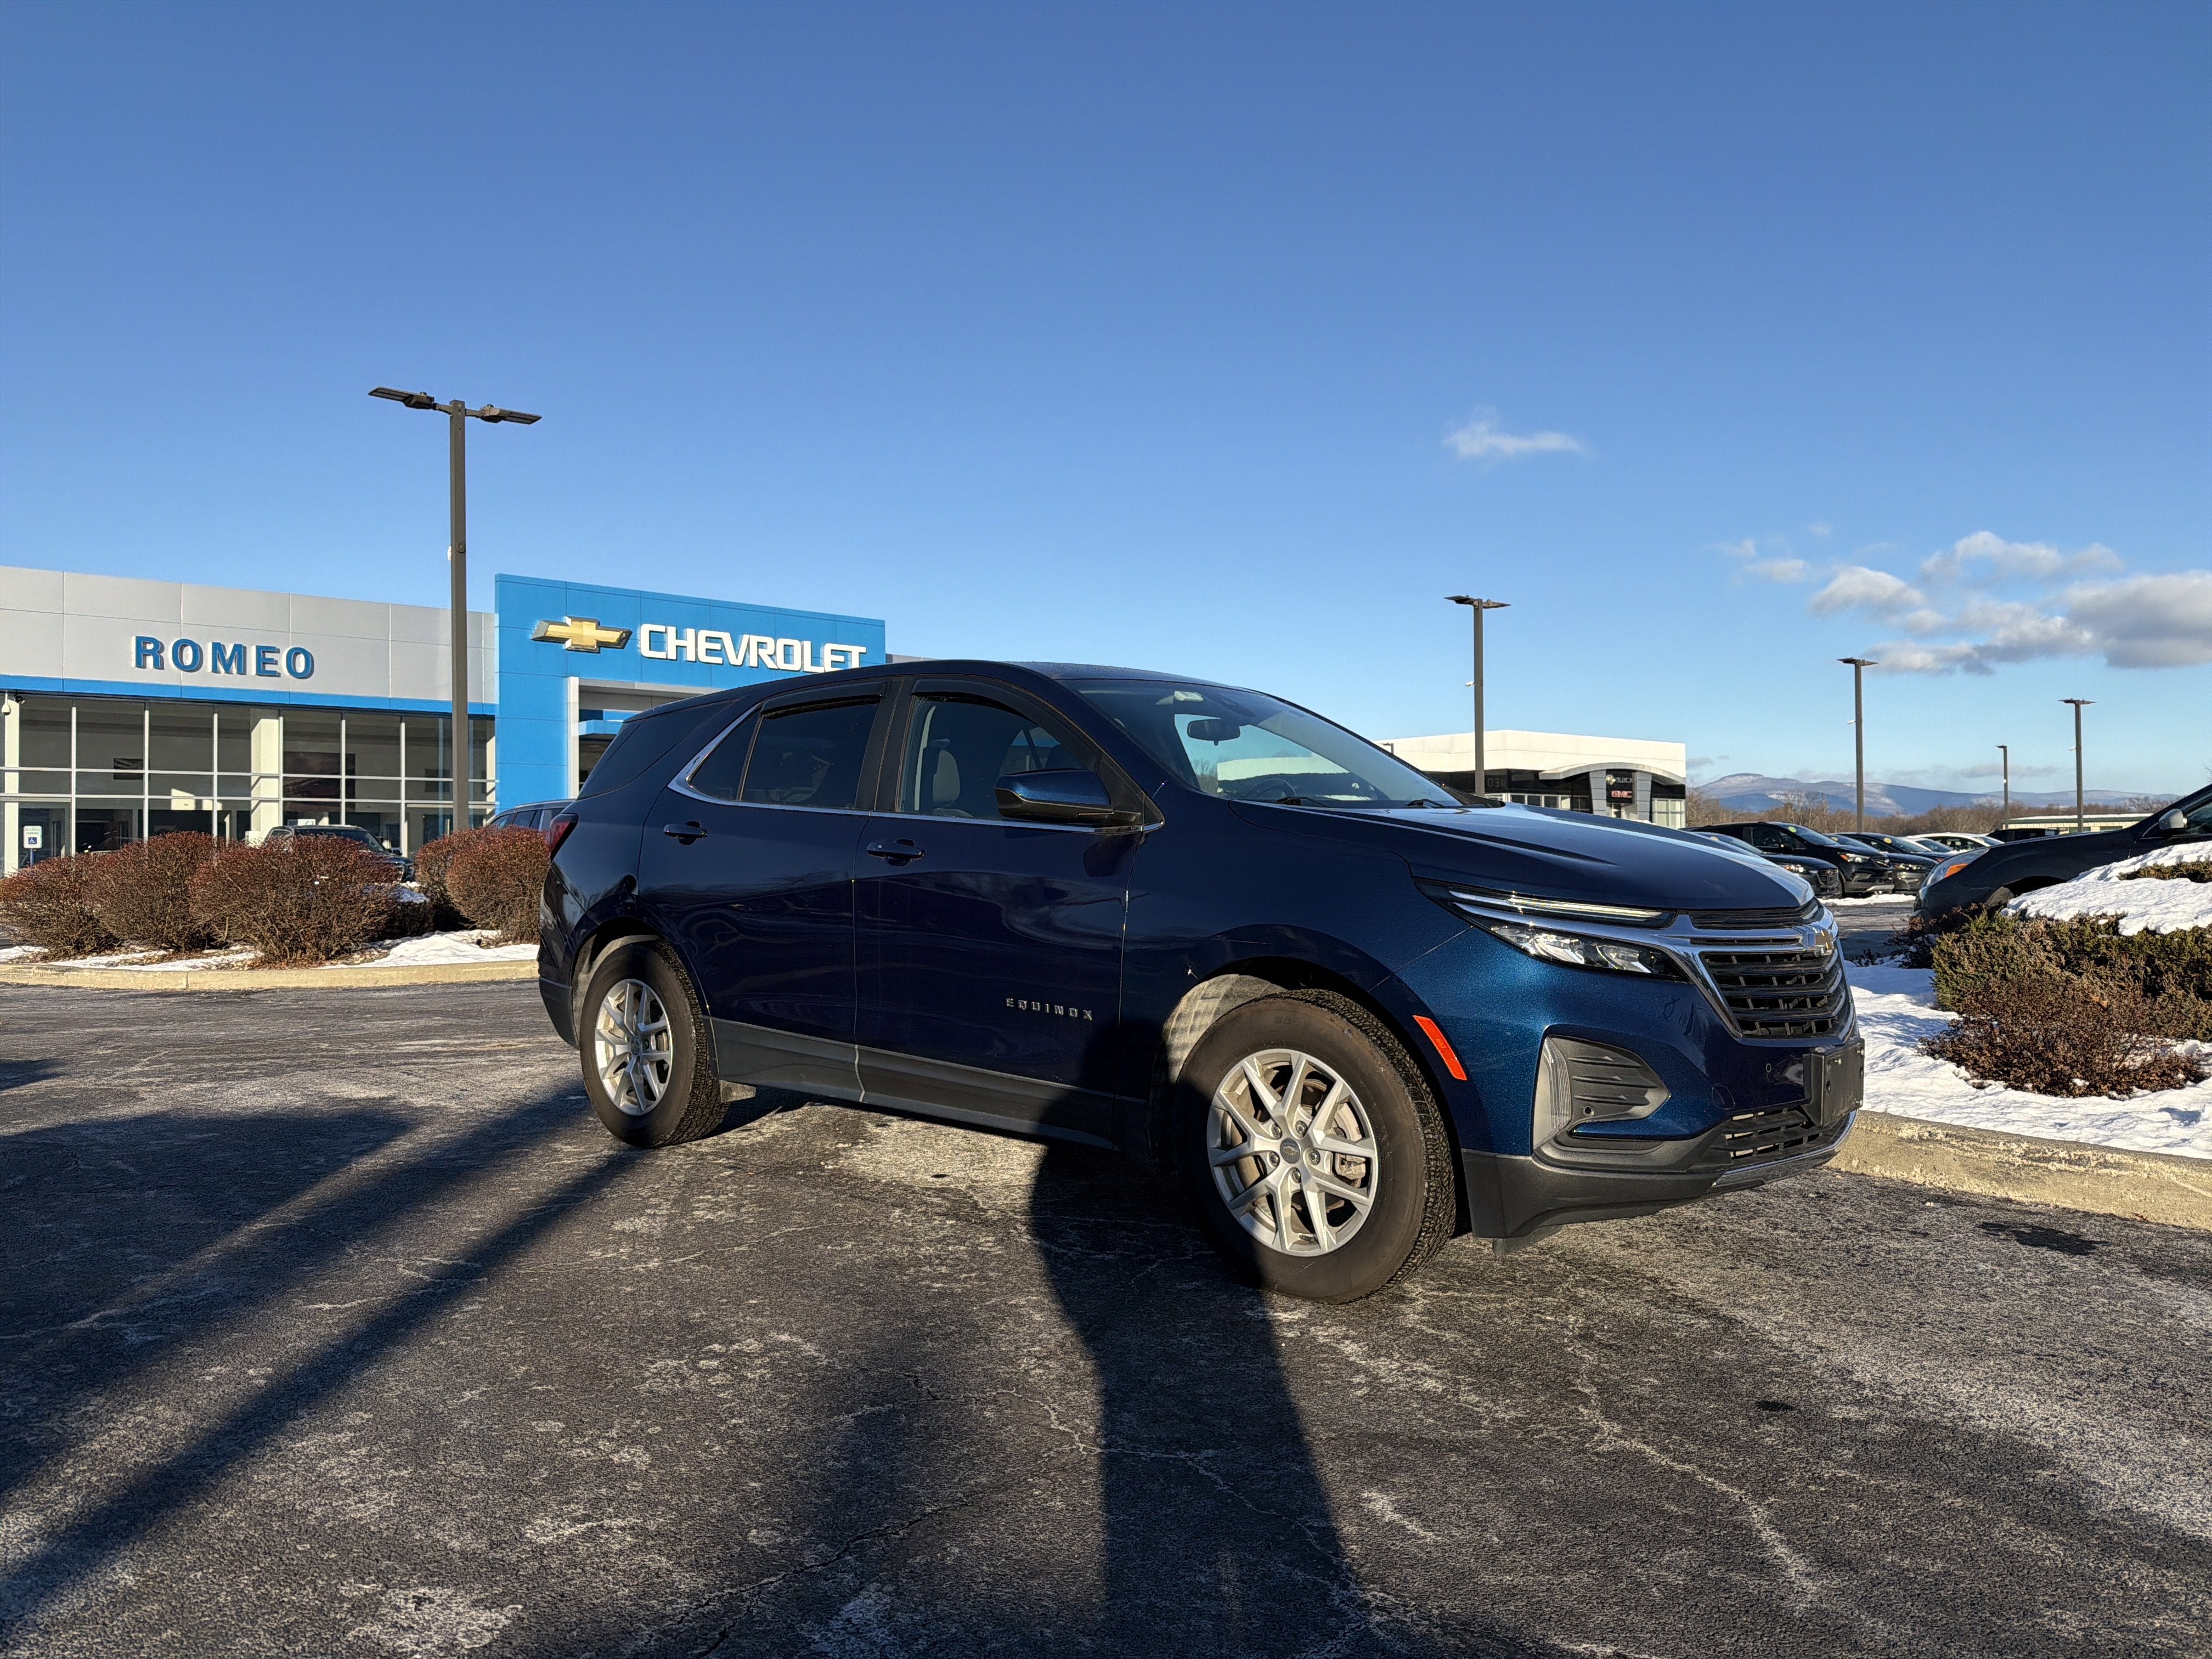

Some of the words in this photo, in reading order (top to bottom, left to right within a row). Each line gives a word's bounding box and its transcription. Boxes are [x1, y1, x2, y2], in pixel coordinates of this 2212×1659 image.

[133, 635, 313, 679] ROMEO
[640, 624, 866, 673] CHEVROLET
[1005, 998, 1093, 1020] EQUINOX
